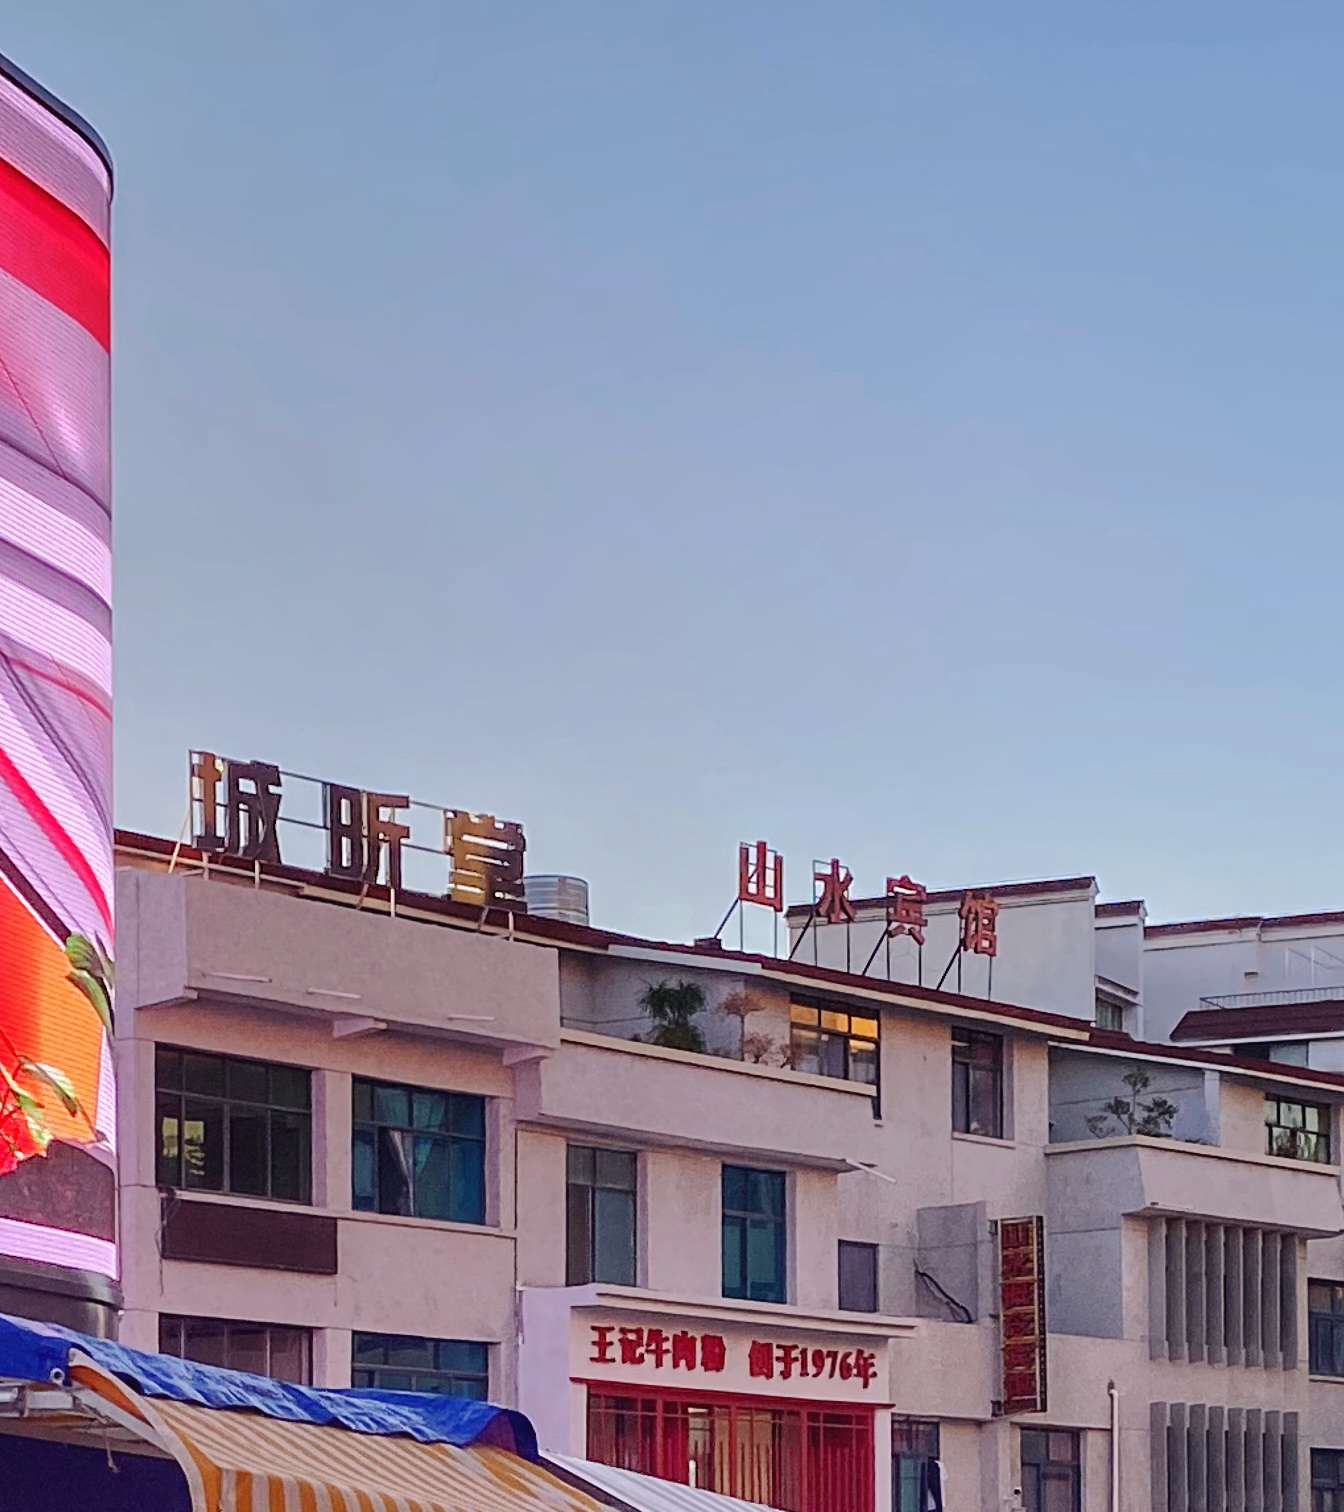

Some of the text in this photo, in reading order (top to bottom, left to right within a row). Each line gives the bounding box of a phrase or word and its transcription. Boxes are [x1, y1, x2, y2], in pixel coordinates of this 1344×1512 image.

[738, 840, 1000, 957] 山水宾馆
[589, 1325, 879, 1390] 王记牛肉粉 创于1976年
